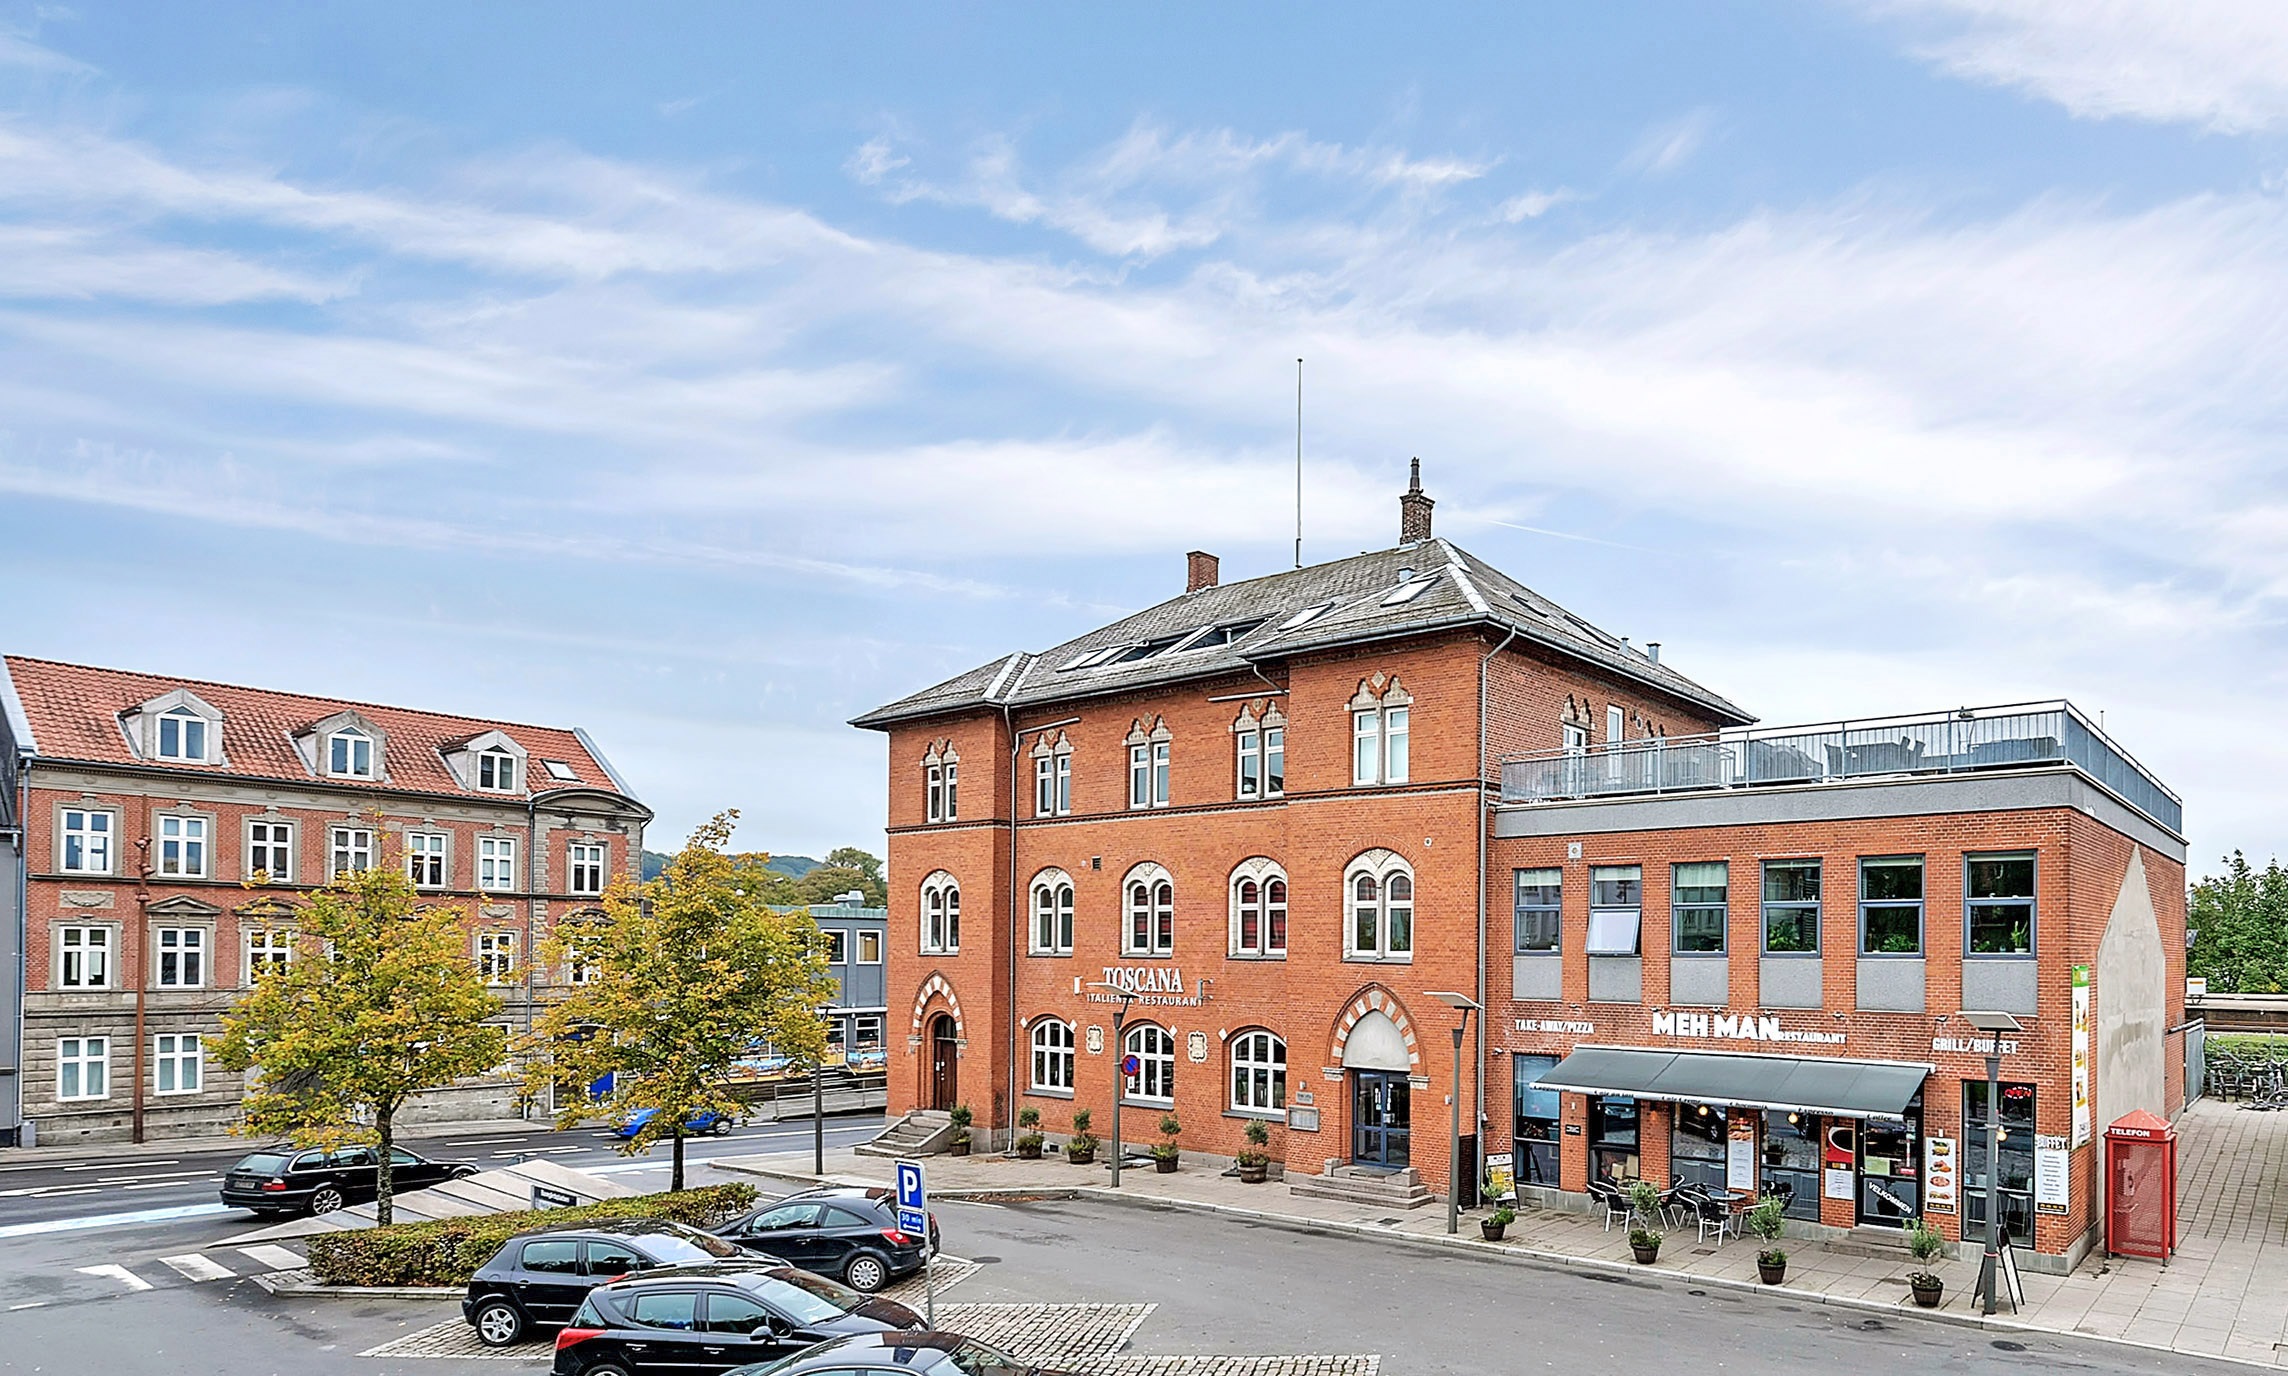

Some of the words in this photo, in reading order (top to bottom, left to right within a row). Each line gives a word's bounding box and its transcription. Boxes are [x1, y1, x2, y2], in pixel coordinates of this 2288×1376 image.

[1102, 966, 1184, 993] TOSCANA
[1652, 1012, 1709, 1038] MEH
[1713, 1015, 1780, 1042] MAN
[1778, 1030, 1847, 1044] RESTAURANT
[1932, 1037, 2019, 1054] GRILL/BUFFET
[2110, 1128, 2150, 1138] TELEFON
[903, 1170, 918, 1203] P
[1868, 1181, 1913, 1214] VELKOMMEN
